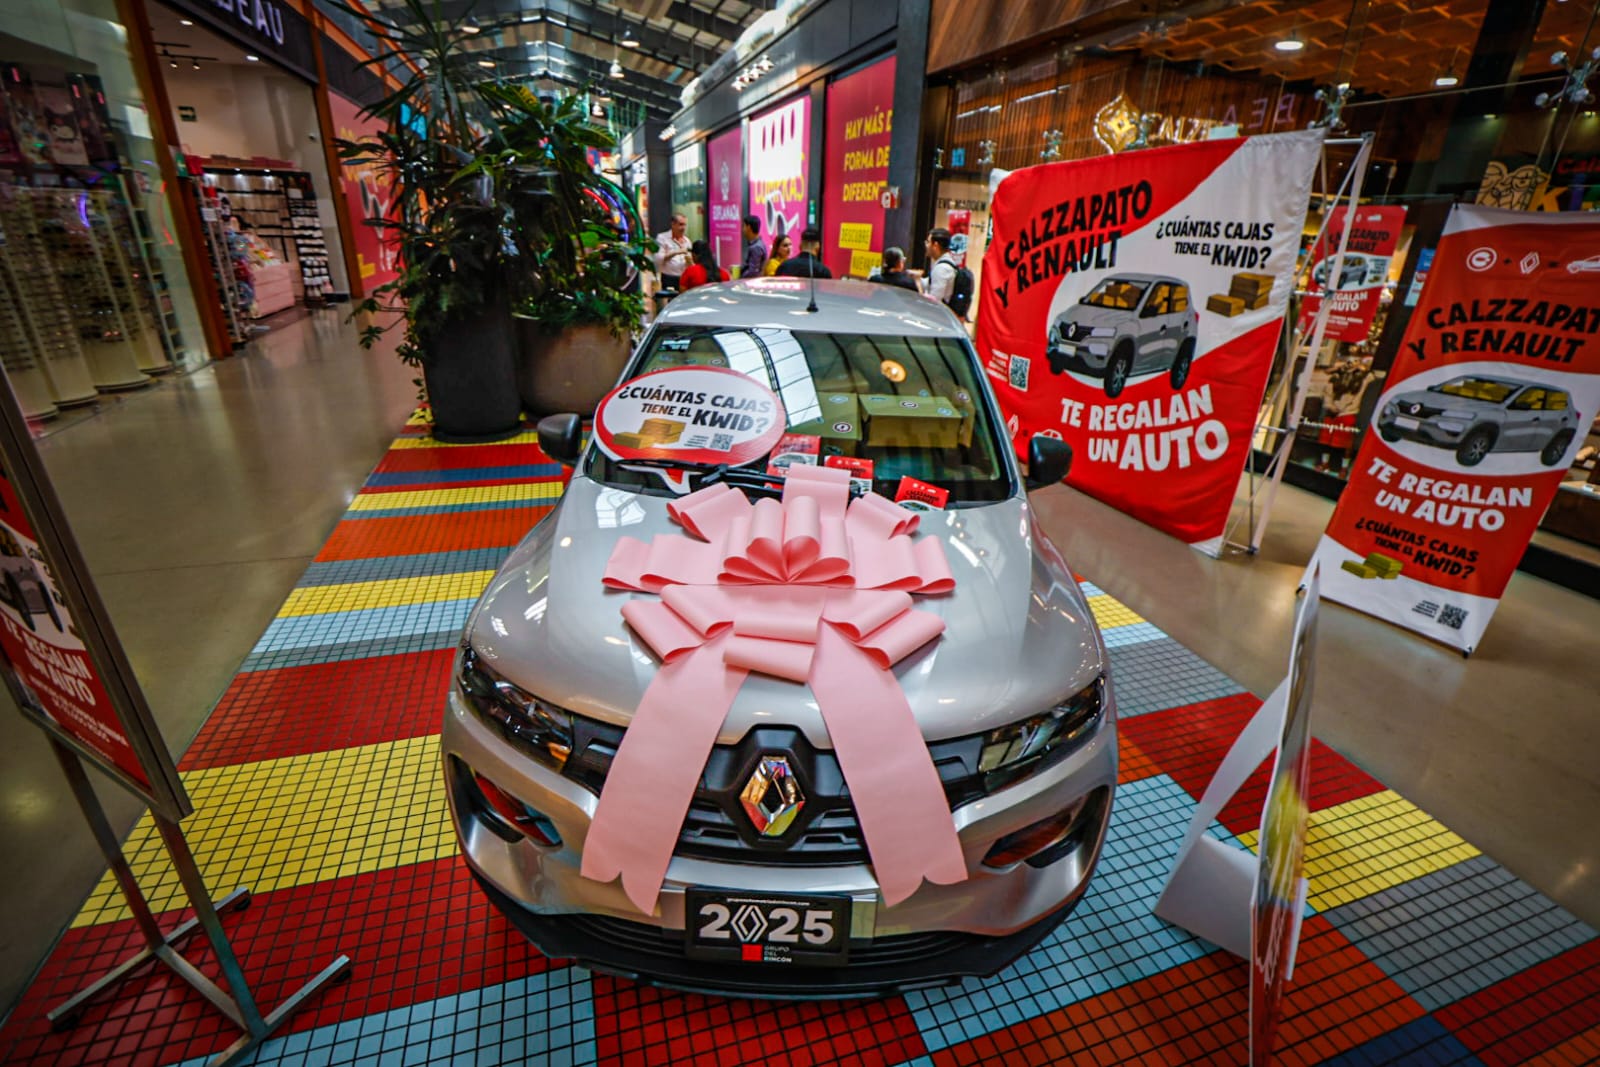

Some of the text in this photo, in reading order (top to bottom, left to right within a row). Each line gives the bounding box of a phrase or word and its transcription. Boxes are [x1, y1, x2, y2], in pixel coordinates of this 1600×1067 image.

[845, 118, 863, 141] HAY
[864, 105, 884, 136] MÁS
[844, 146, 891, 171] FORMA DE
[1004, 180, 1153, 269] CALZZAPATO
[1156, 215, 1274, 241] ¿CUÁNTAS CAJAS
[995, 230, 1122, 308] Y RENAULT
[1175, 242, 1272, 269] TIENE EL KWID?
[1408, 329, 1586, 364] Y RENAULT
[618, 385, 771, 413] ¿CUÁNTAS CAJAS
[641, 403, 769, 434] TIENE EL KWID?
[1060, 384, 1214, 432] TE REGALAN
[1087, 419, 1230, 472] UN AUTO
[1366, 457, 1533, 508] TE REGALAN
[1375, 490, 1506, 532] UN AUTO
[1355, 517, 1480, 563] ¿CUÁNTAS CAJAS
[1374, 536, 1476, 580] TIENE EL KWID?
